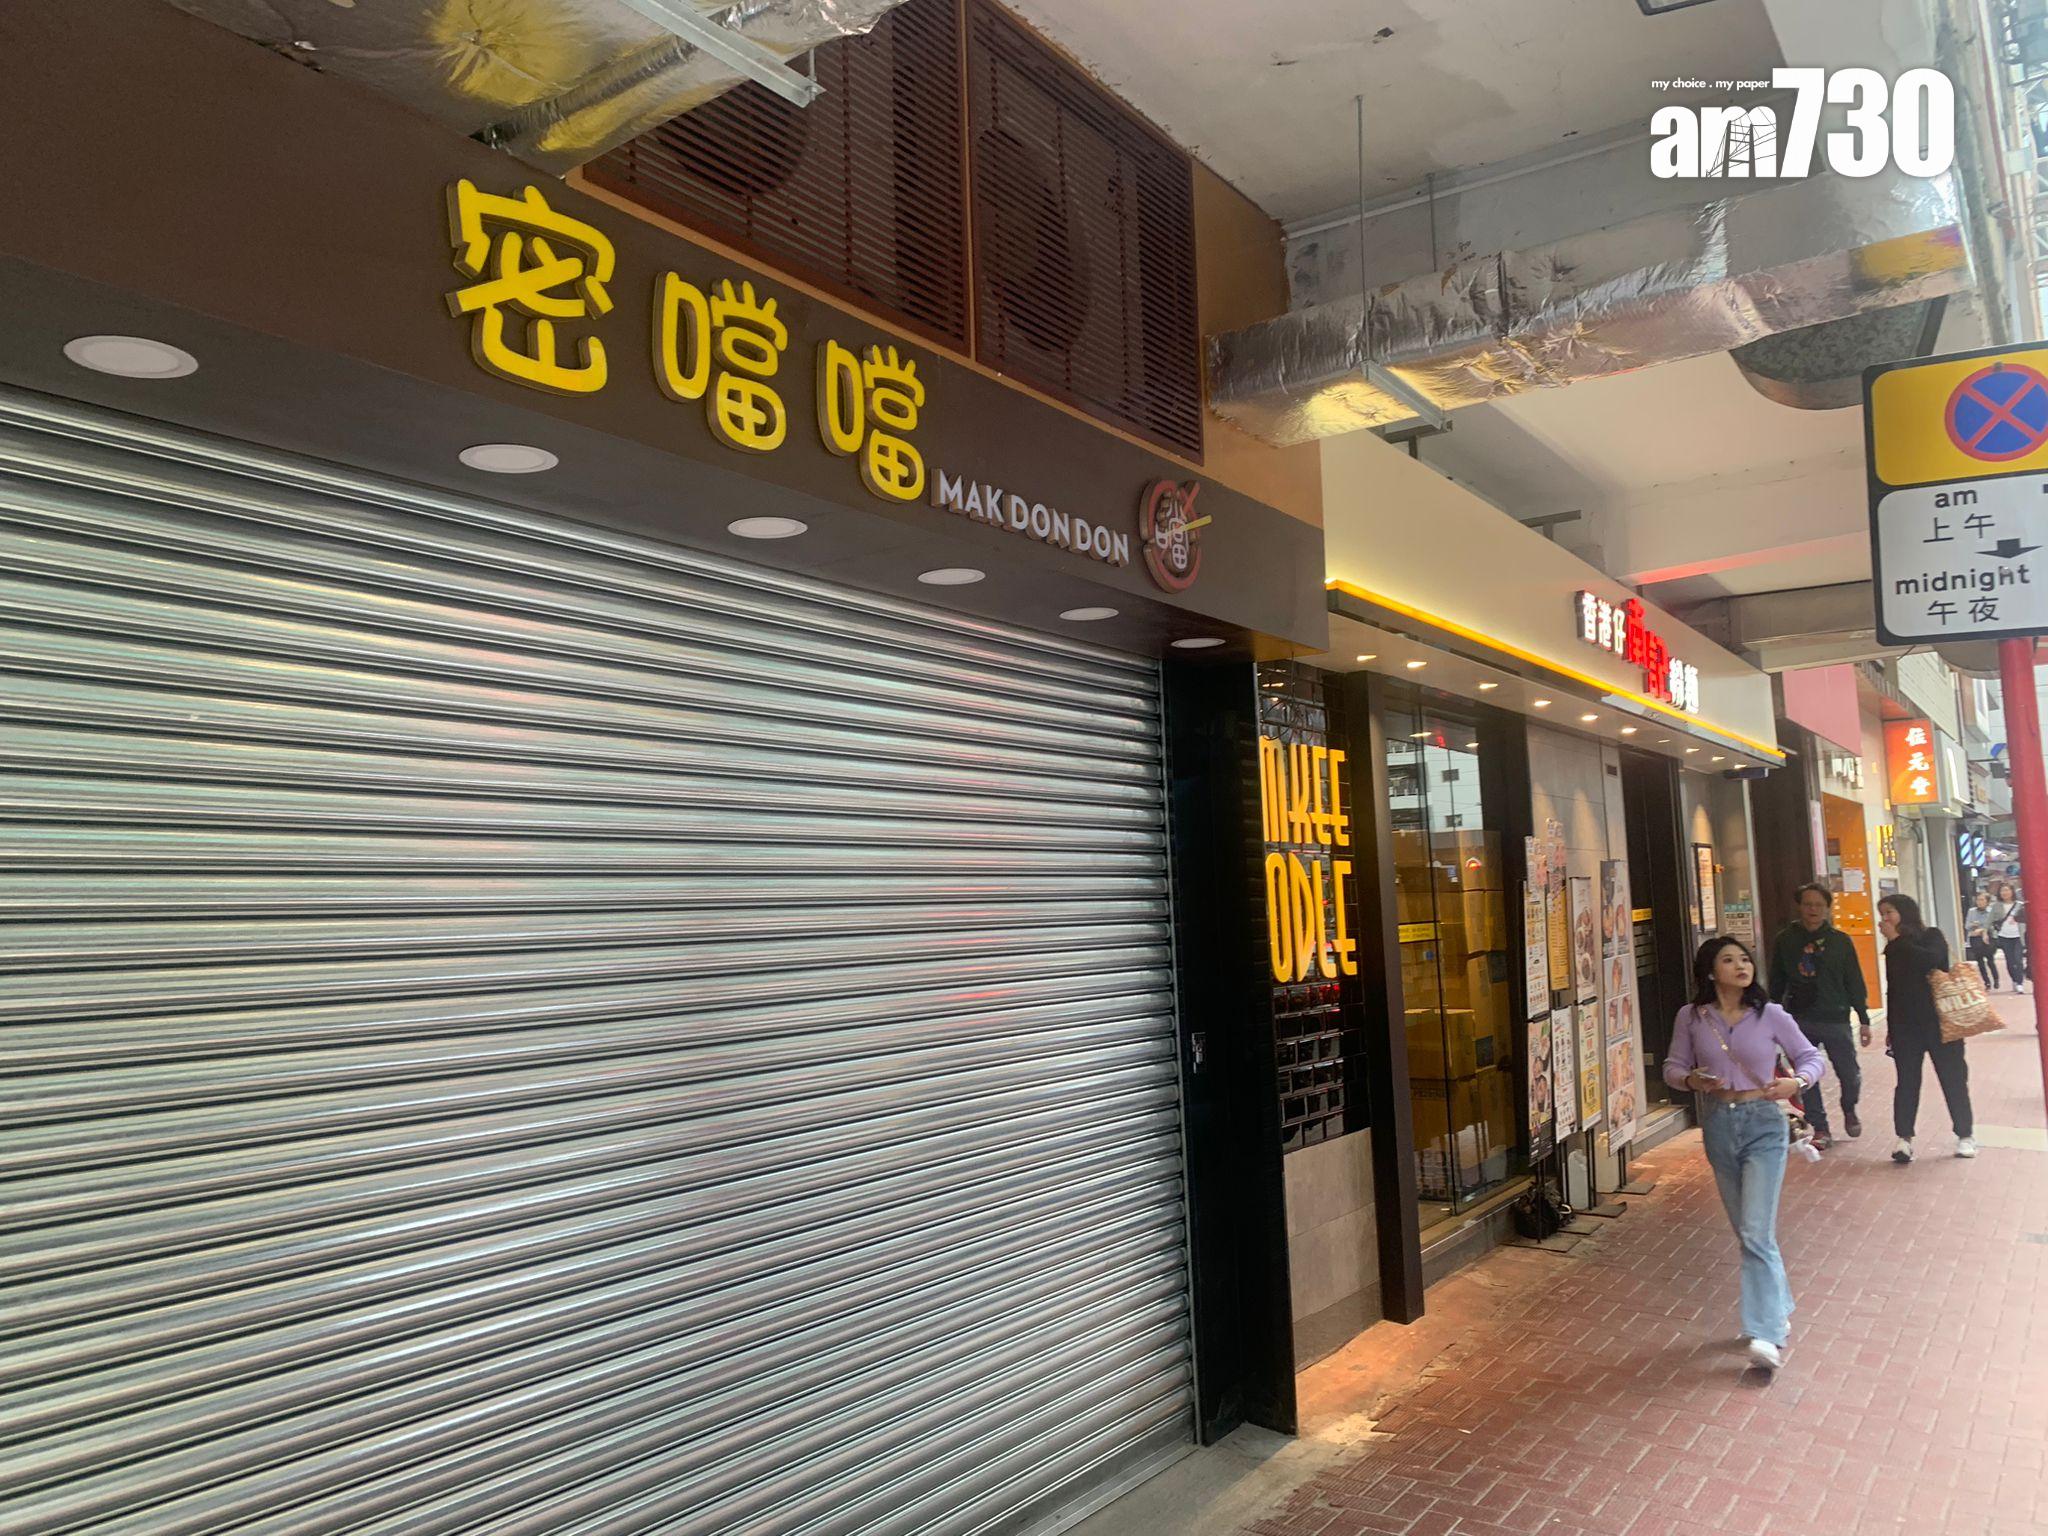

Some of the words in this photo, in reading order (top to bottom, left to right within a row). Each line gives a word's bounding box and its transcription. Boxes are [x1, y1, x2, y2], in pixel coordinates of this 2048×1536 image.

[449, 177, 926, 502] 密噹噹
[935, 468, 1004, 525] MAK
[1934, 489, 1978, 509] am
[1923, 513, 1996, 544] 上午
[1895, 564, 2031, 595] midnight
[1926, 597, 1999, 626] 午夜
